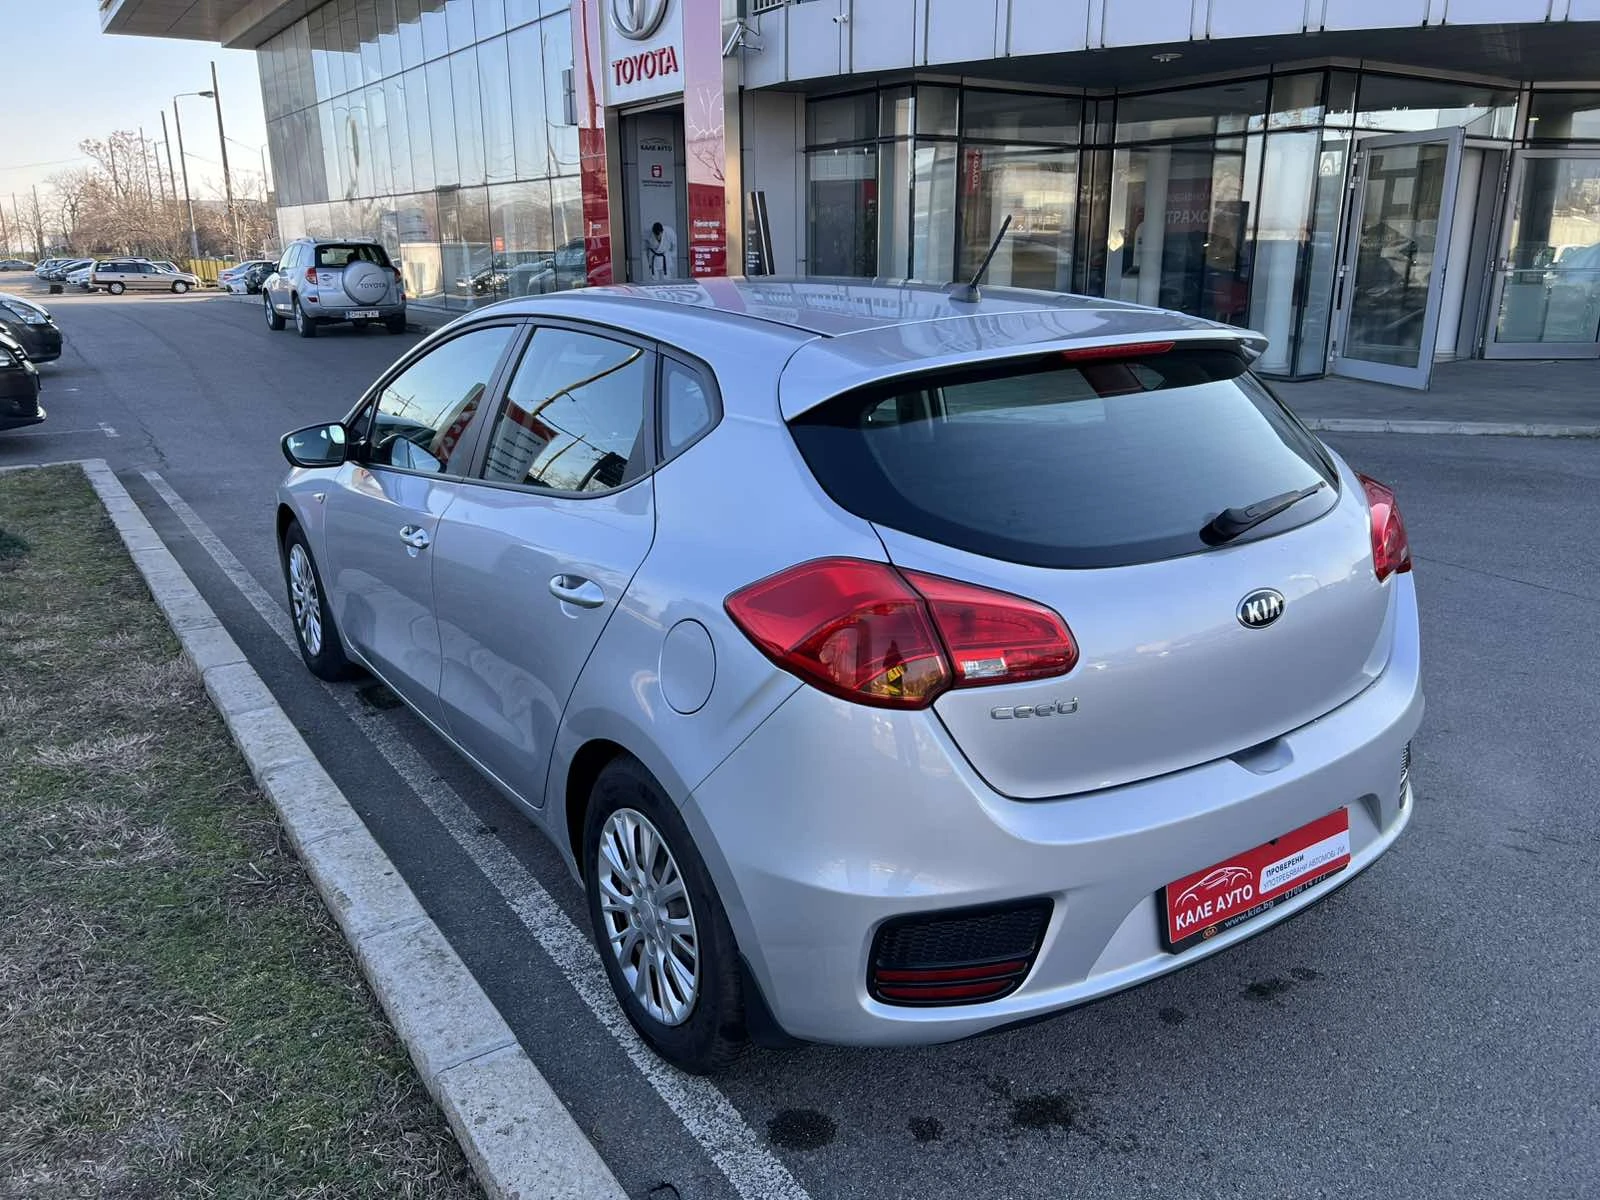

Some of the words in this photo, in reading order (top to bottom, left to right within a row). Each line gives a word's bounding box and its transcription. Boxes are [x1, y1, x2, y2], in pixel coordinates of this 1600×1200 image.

[612, 46, 679, 86] TOYOTA
[1246, 596, 1283, 622] KIA
[1266, 854, 1305, 878] ПРОВЕРЕНИ
[1175, 901, 1213, 931] КАЛЕ
[1216, 884, 1254, 913] АУТО
